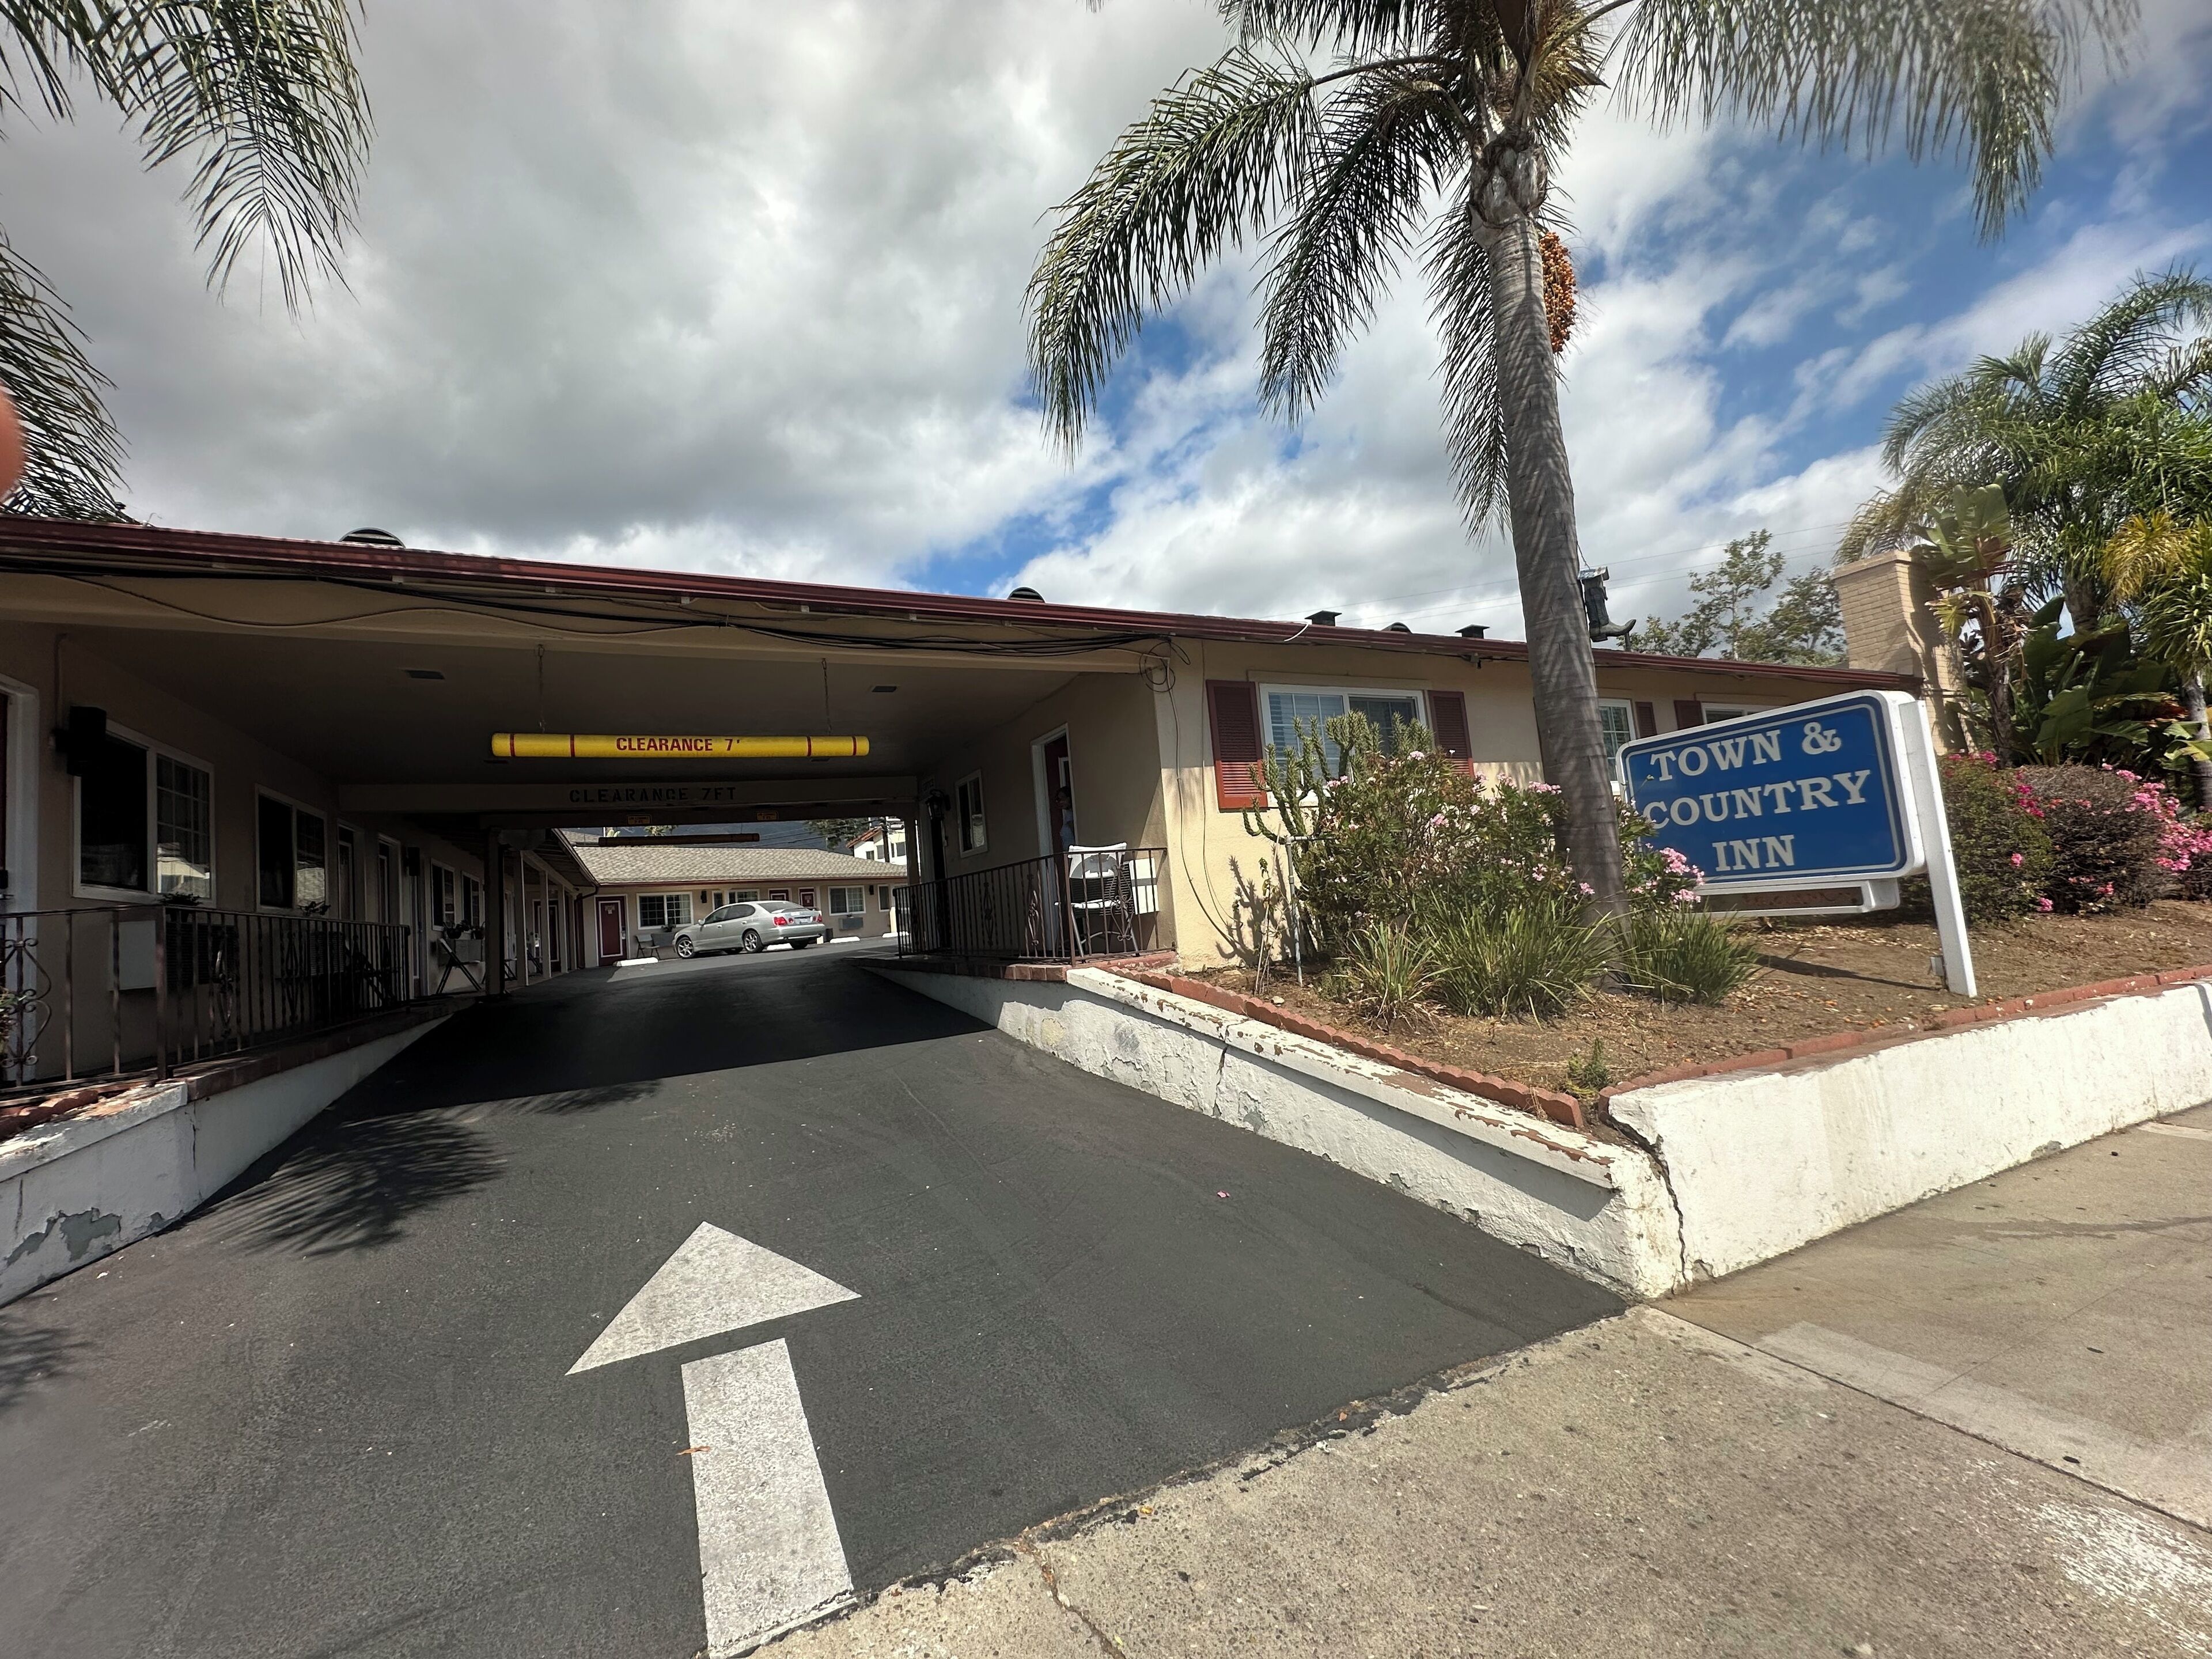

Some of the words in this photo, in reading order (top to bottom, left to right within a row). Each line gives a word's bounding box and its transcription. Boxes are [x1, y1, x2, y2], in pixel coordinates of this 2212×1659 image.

[616, 737, 713, 751] CLEARANCE
[725, 738, 740, 751] 7'
[1650, 729, 1781, 782] TOWN
[1801, 721, 1842, 755] &
[569, 787, 689, 803] CLEARANCE
[1643, 770, 1872, 830] COUNTRY
[1711, 834, 1796, 872] INN
